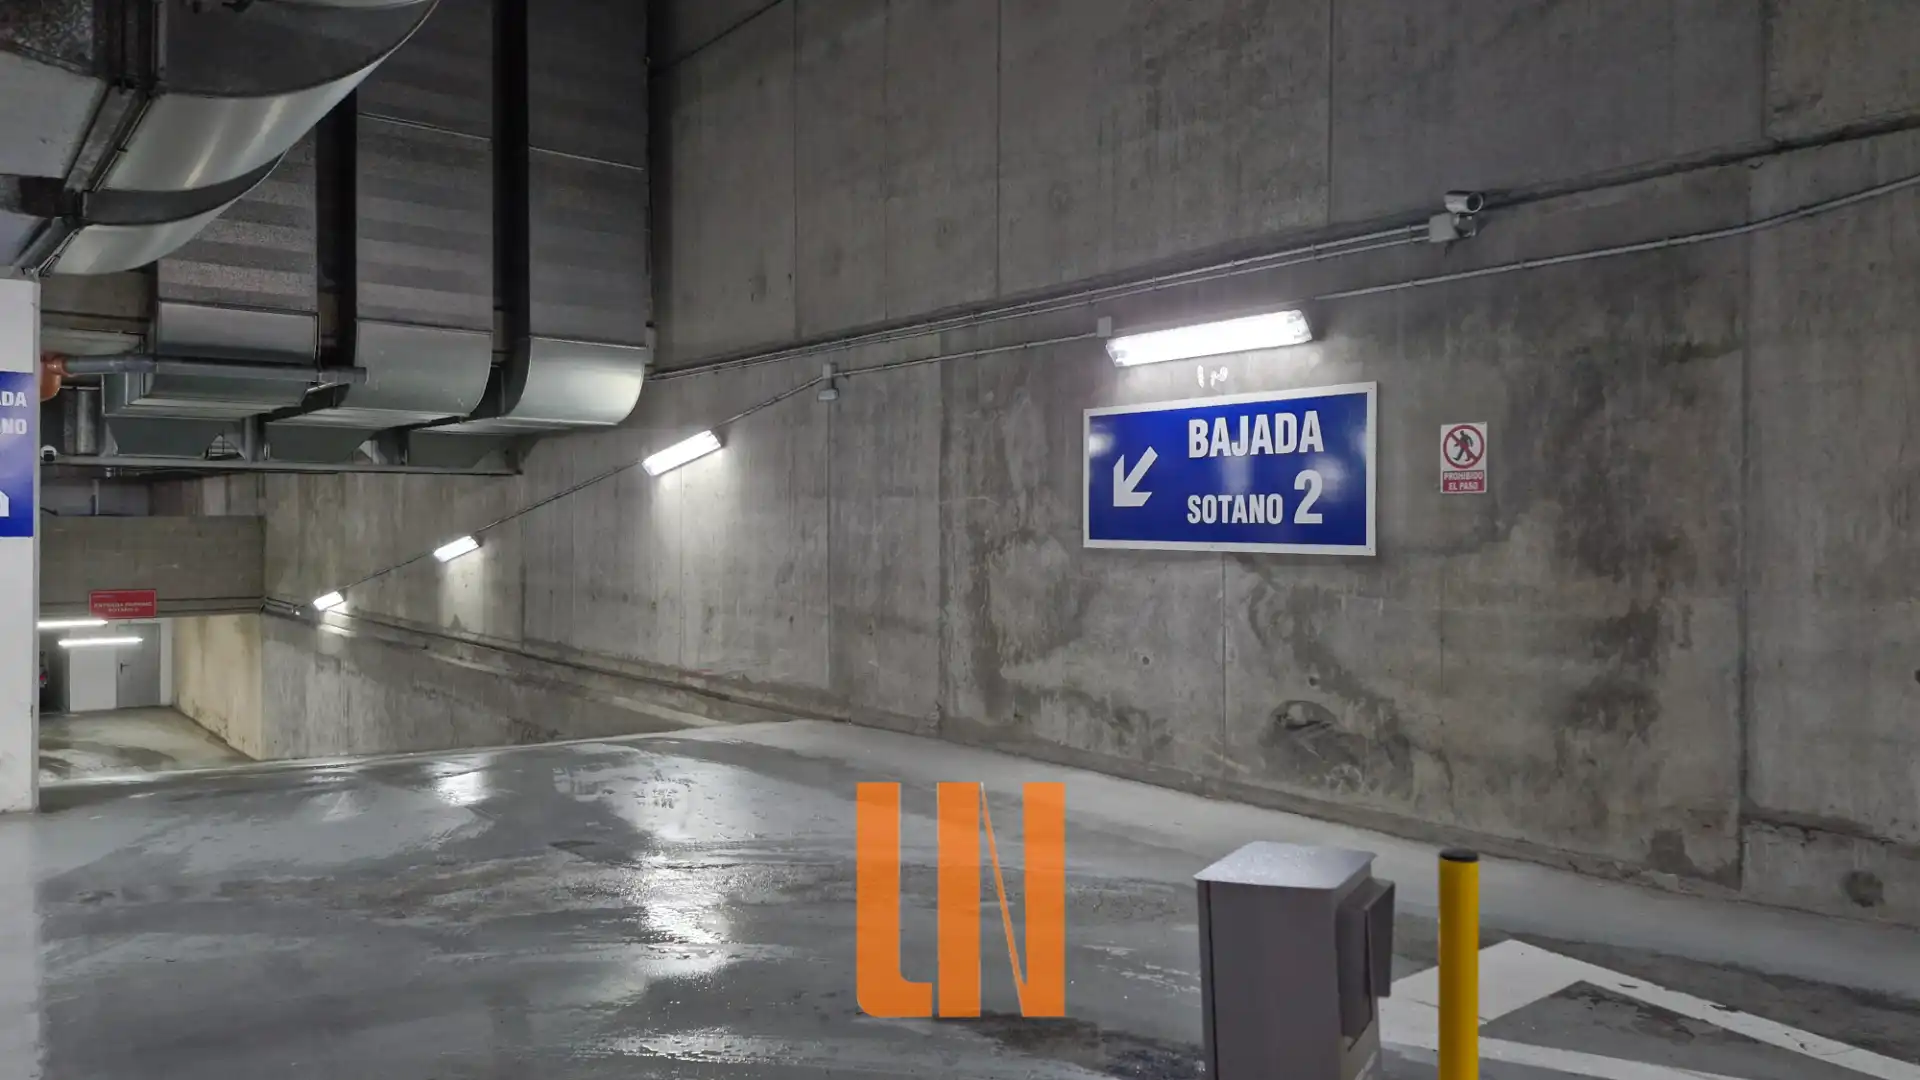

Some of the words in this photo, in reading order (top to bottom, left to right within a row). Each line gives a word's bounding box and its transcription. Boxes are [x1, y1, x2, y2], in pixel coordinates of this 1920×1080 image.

[0, 391, 28, 407] DA
[1188, 410, 1325, 459] BAJADA
[1443, 471, 1483, 480] PROHIBIDO
[1448, 482, 1457, 490] EL
[1460, 482, 1478, 490] PASO
[1187, 494, 1283, 525] SOTANO
[1293, 469, 1324, 524] 2
